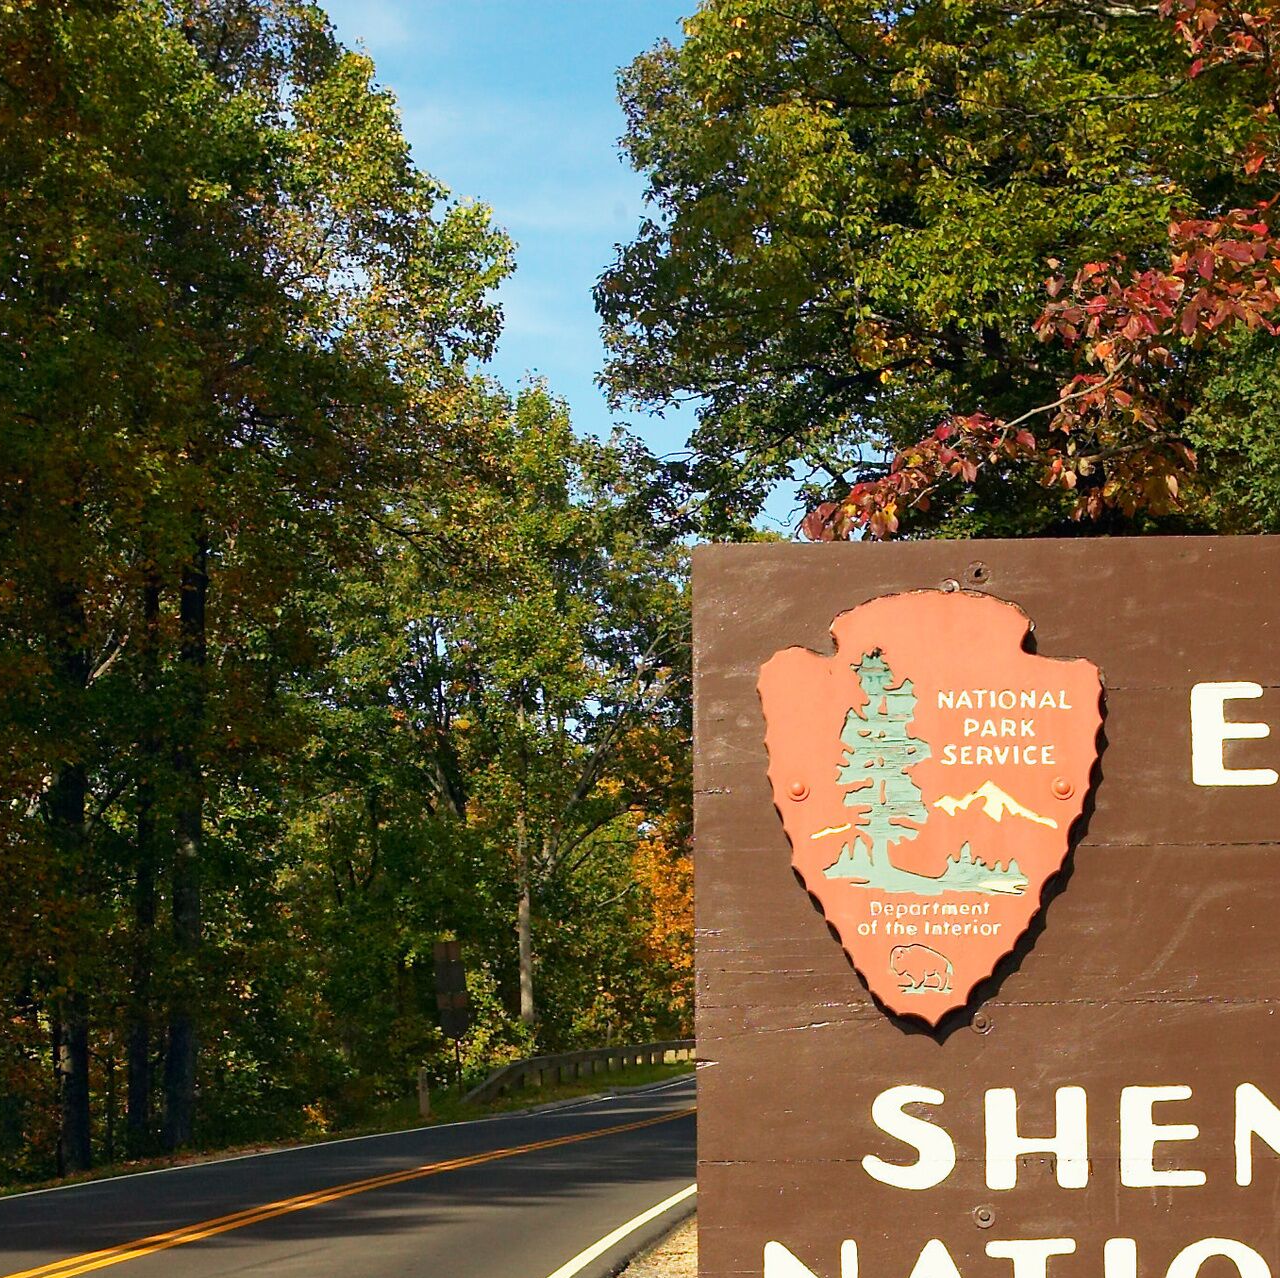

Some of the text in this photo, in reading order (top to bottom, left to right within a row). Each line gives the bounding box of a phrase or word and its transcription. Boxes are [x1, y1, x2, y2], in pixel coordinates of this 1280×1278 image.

[937, 690, 1072, 710] NATIONAL
[964, 718, 1036, 737] PARK
[940, 744, 1056, 766] SERVICE
[870, 901, 990, 917] Department
[857, 920, 1001, 936] of the Interior
